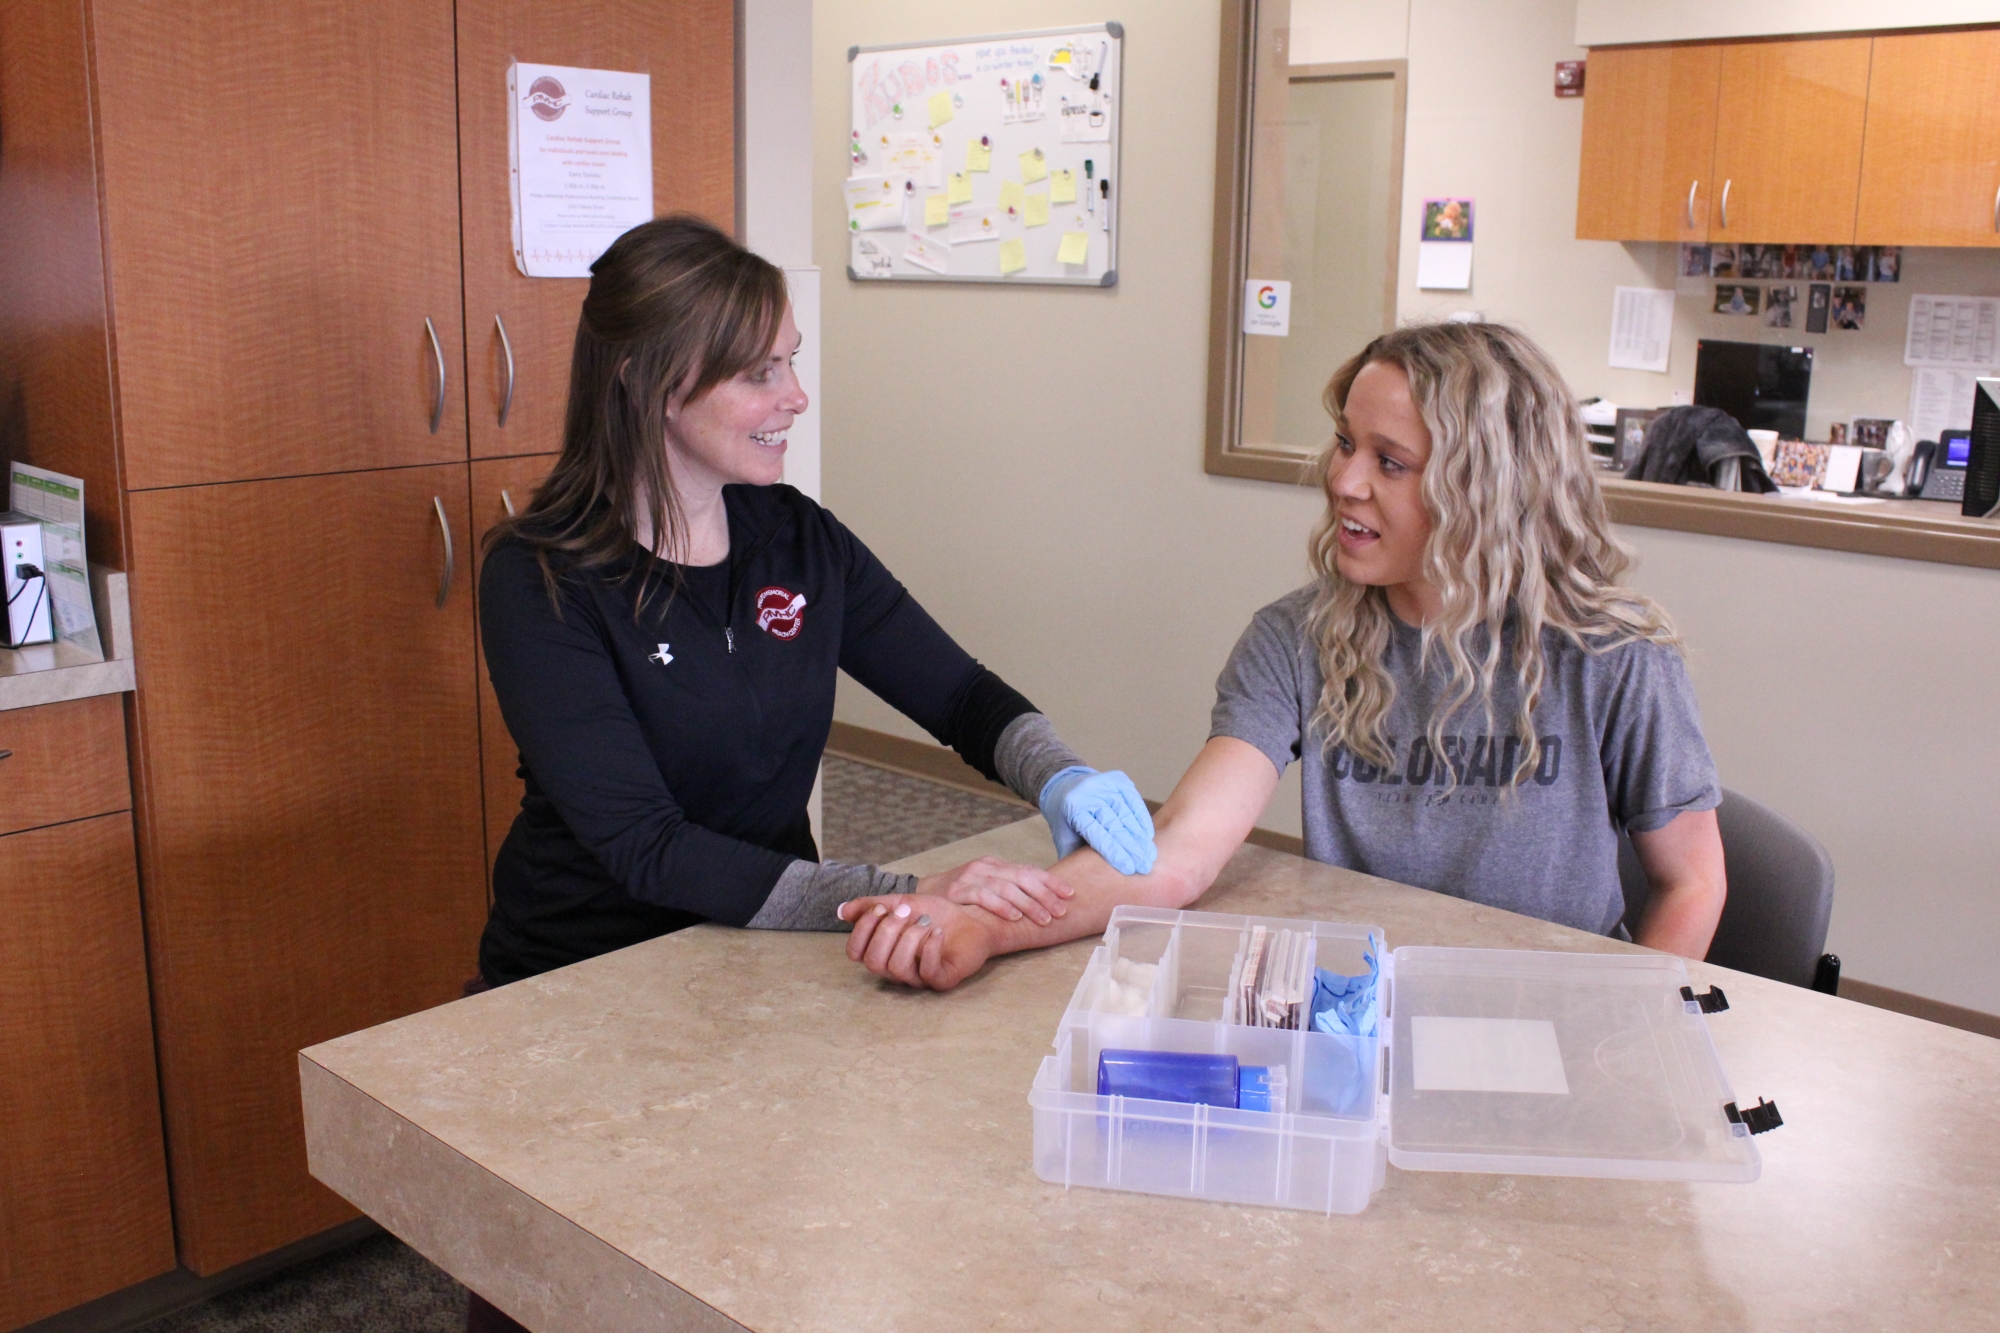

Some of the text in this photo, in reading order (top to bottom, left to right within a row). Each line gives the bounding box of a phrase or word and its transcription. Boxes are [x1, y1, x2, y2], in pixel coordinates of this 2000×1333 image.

[585, 90, 632, 101] Cardiac Rehab
[857, 49, 960, 131] KUDOS
[584, 106, 632, 118] Support Group
[546, 134, 566, 142] Cardiac
[584, 136, 604, 144] Support
